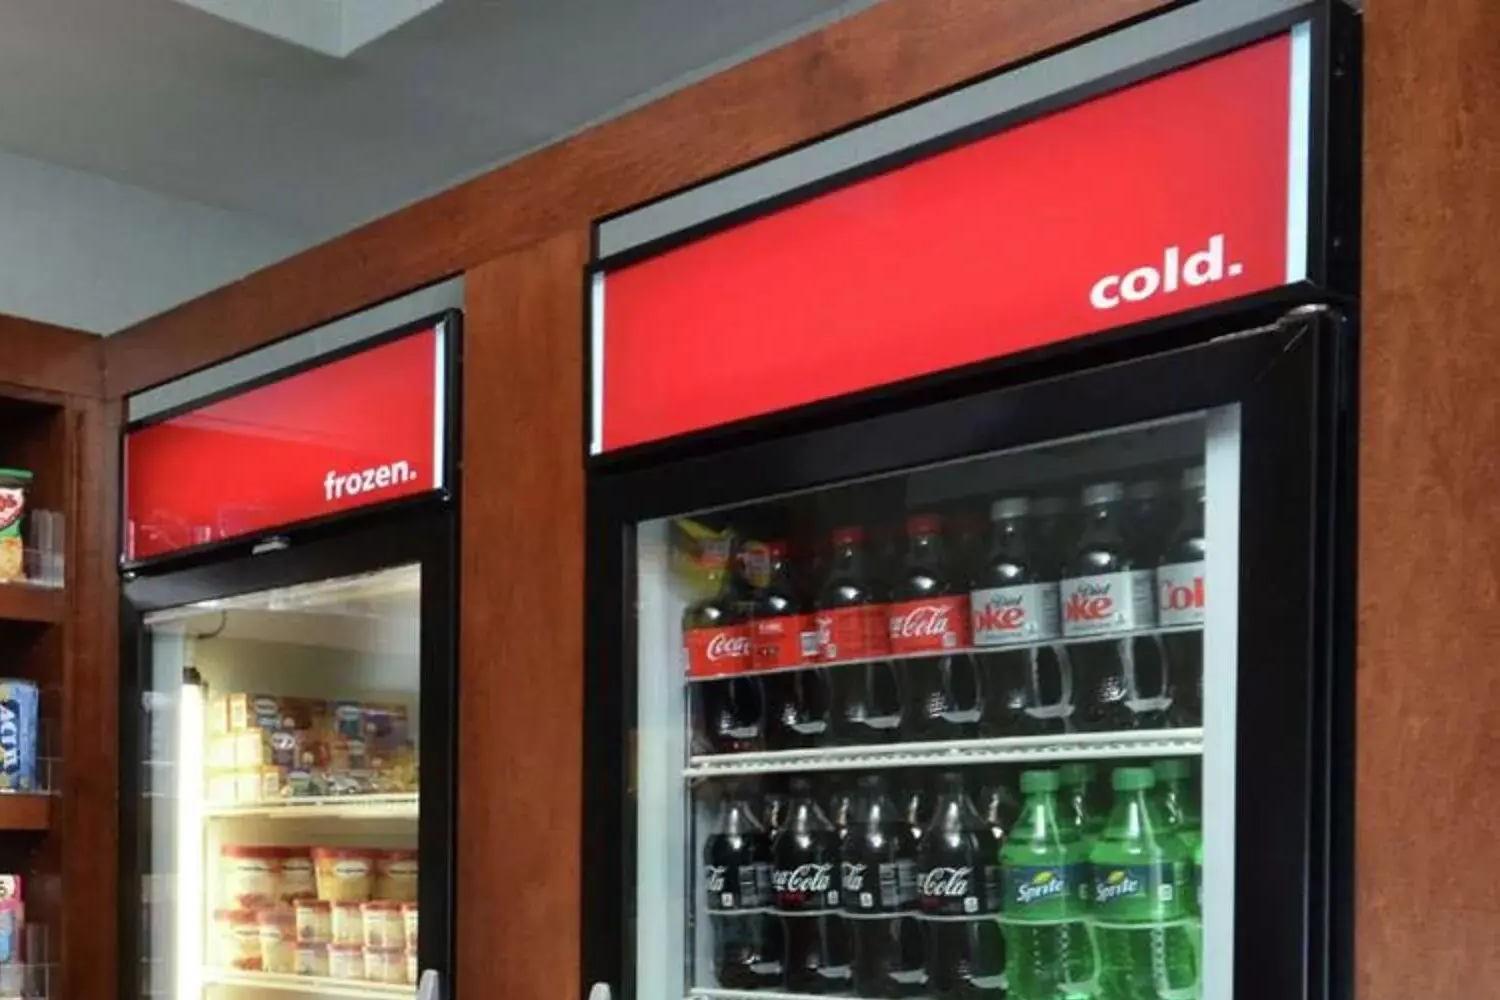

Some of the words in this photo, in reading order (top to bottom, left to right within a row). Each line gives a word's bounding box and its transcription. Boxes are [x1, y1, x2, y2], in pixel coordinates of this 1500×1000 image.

[1089, 233, 1243, 309] cold.
[323, 459, 418, 501] frozen.
[1016, 878, 1064, 903] Sprite
